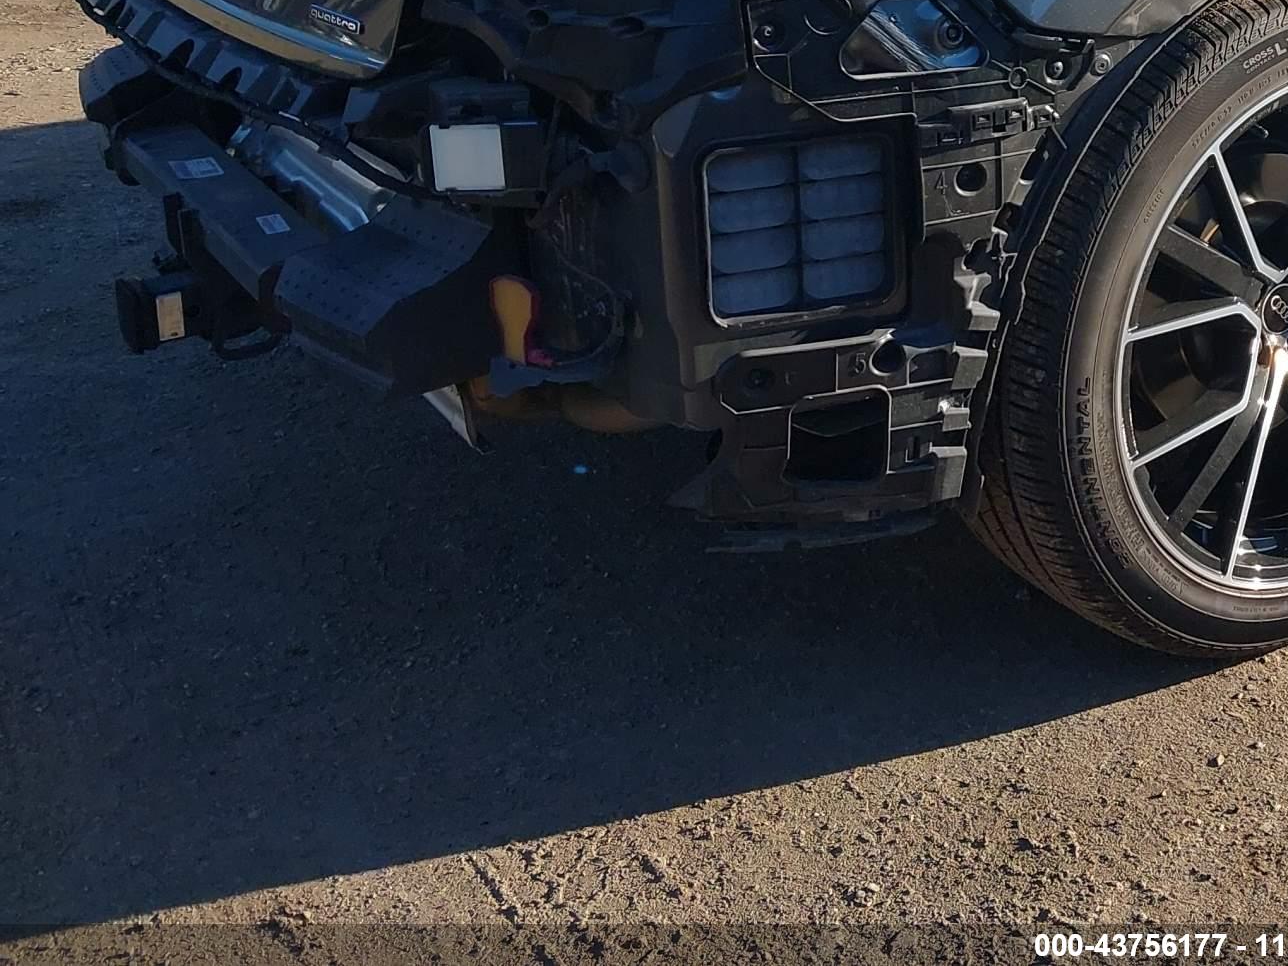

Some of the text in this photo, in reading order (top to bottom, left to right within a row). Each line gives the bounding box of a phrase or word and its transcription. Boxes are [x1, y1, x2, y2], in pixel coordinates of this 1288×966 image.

[310, 8, 356, 31] quattro
[1242, 46, 1275, 69] CROSS
[1245, 54, 1276, 75] CONTACT
[1076, 377, 1133, 570] CONTINENTAL
